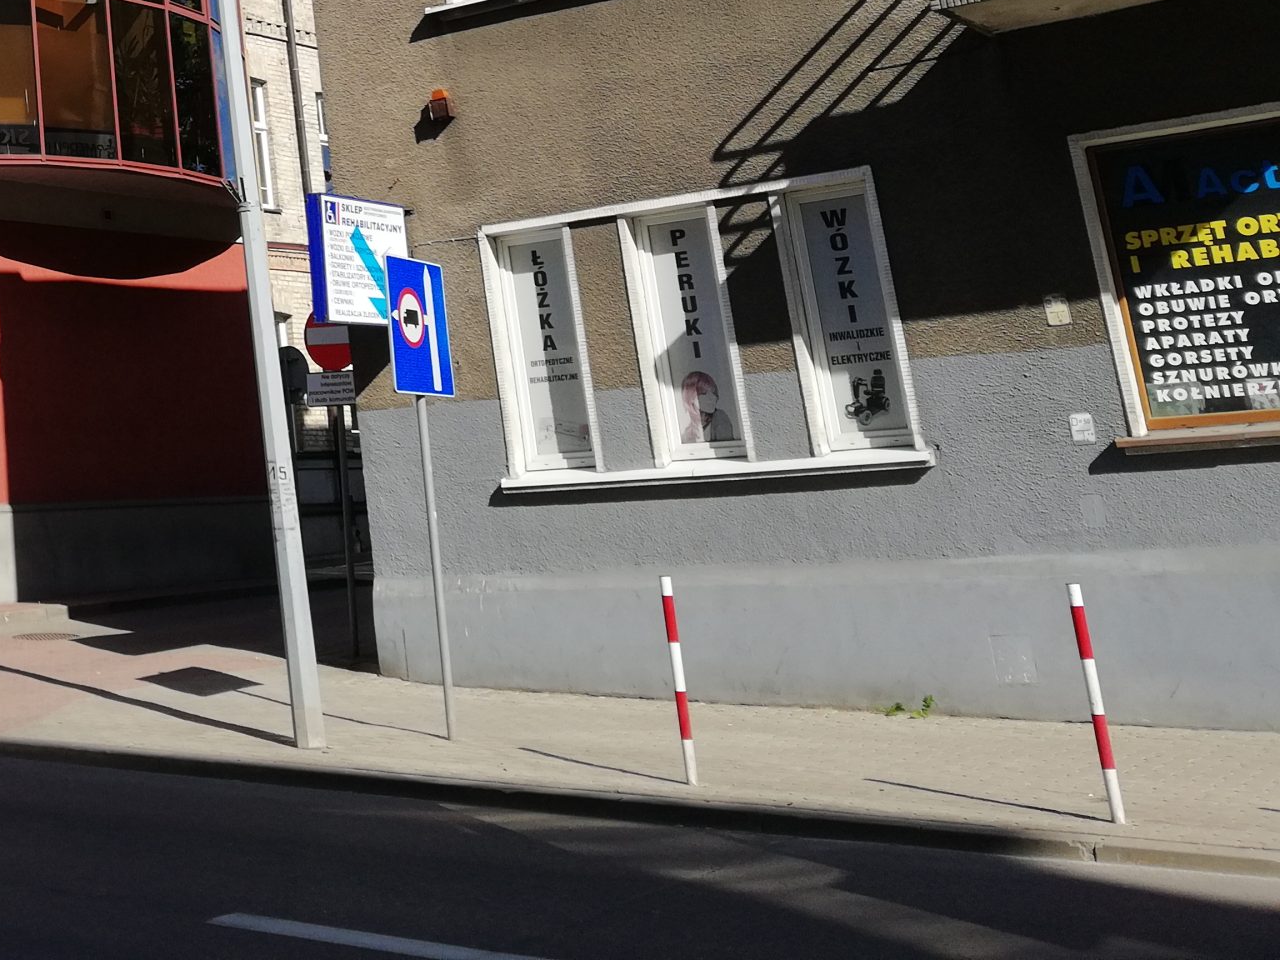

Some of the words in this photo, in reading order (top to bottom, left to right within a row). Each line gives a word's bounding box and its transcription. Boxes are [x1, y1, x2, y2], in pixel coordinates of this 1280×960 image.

[341, 203, 363, 215] SKLEP
[341, 217, 402, 234] REHABILITACYJNY
[1125, 220, 1227, 250] SPRZĘT
[1236, 213, 1280, 237] OR
[820, 208, 859, 323] WÓZKI
[670, 229, 702, 359] PERUKI
[1134, 275, 1243, 299] WKŁADKI
[1139, 294, 1231, 317] OBUWIE
[1244, 289, 1280, 306] OR
[1142, 310, 1245, 334] PROTEZY
[829, 327, 885, 342] INWALIDZKIE
[1145, 328, 1250, 351] APARATY
[530, 356, 574, 368] ORTOPEDYCZNE
[831, 351, 892, 366] ELEKTRYCZNE
[1149, 346, 1254, 368] GORSETY
[529, 373, 579, 385] REHABILITACYJNE
[1155, 380, 1280, 403] KOŁNIERZ
